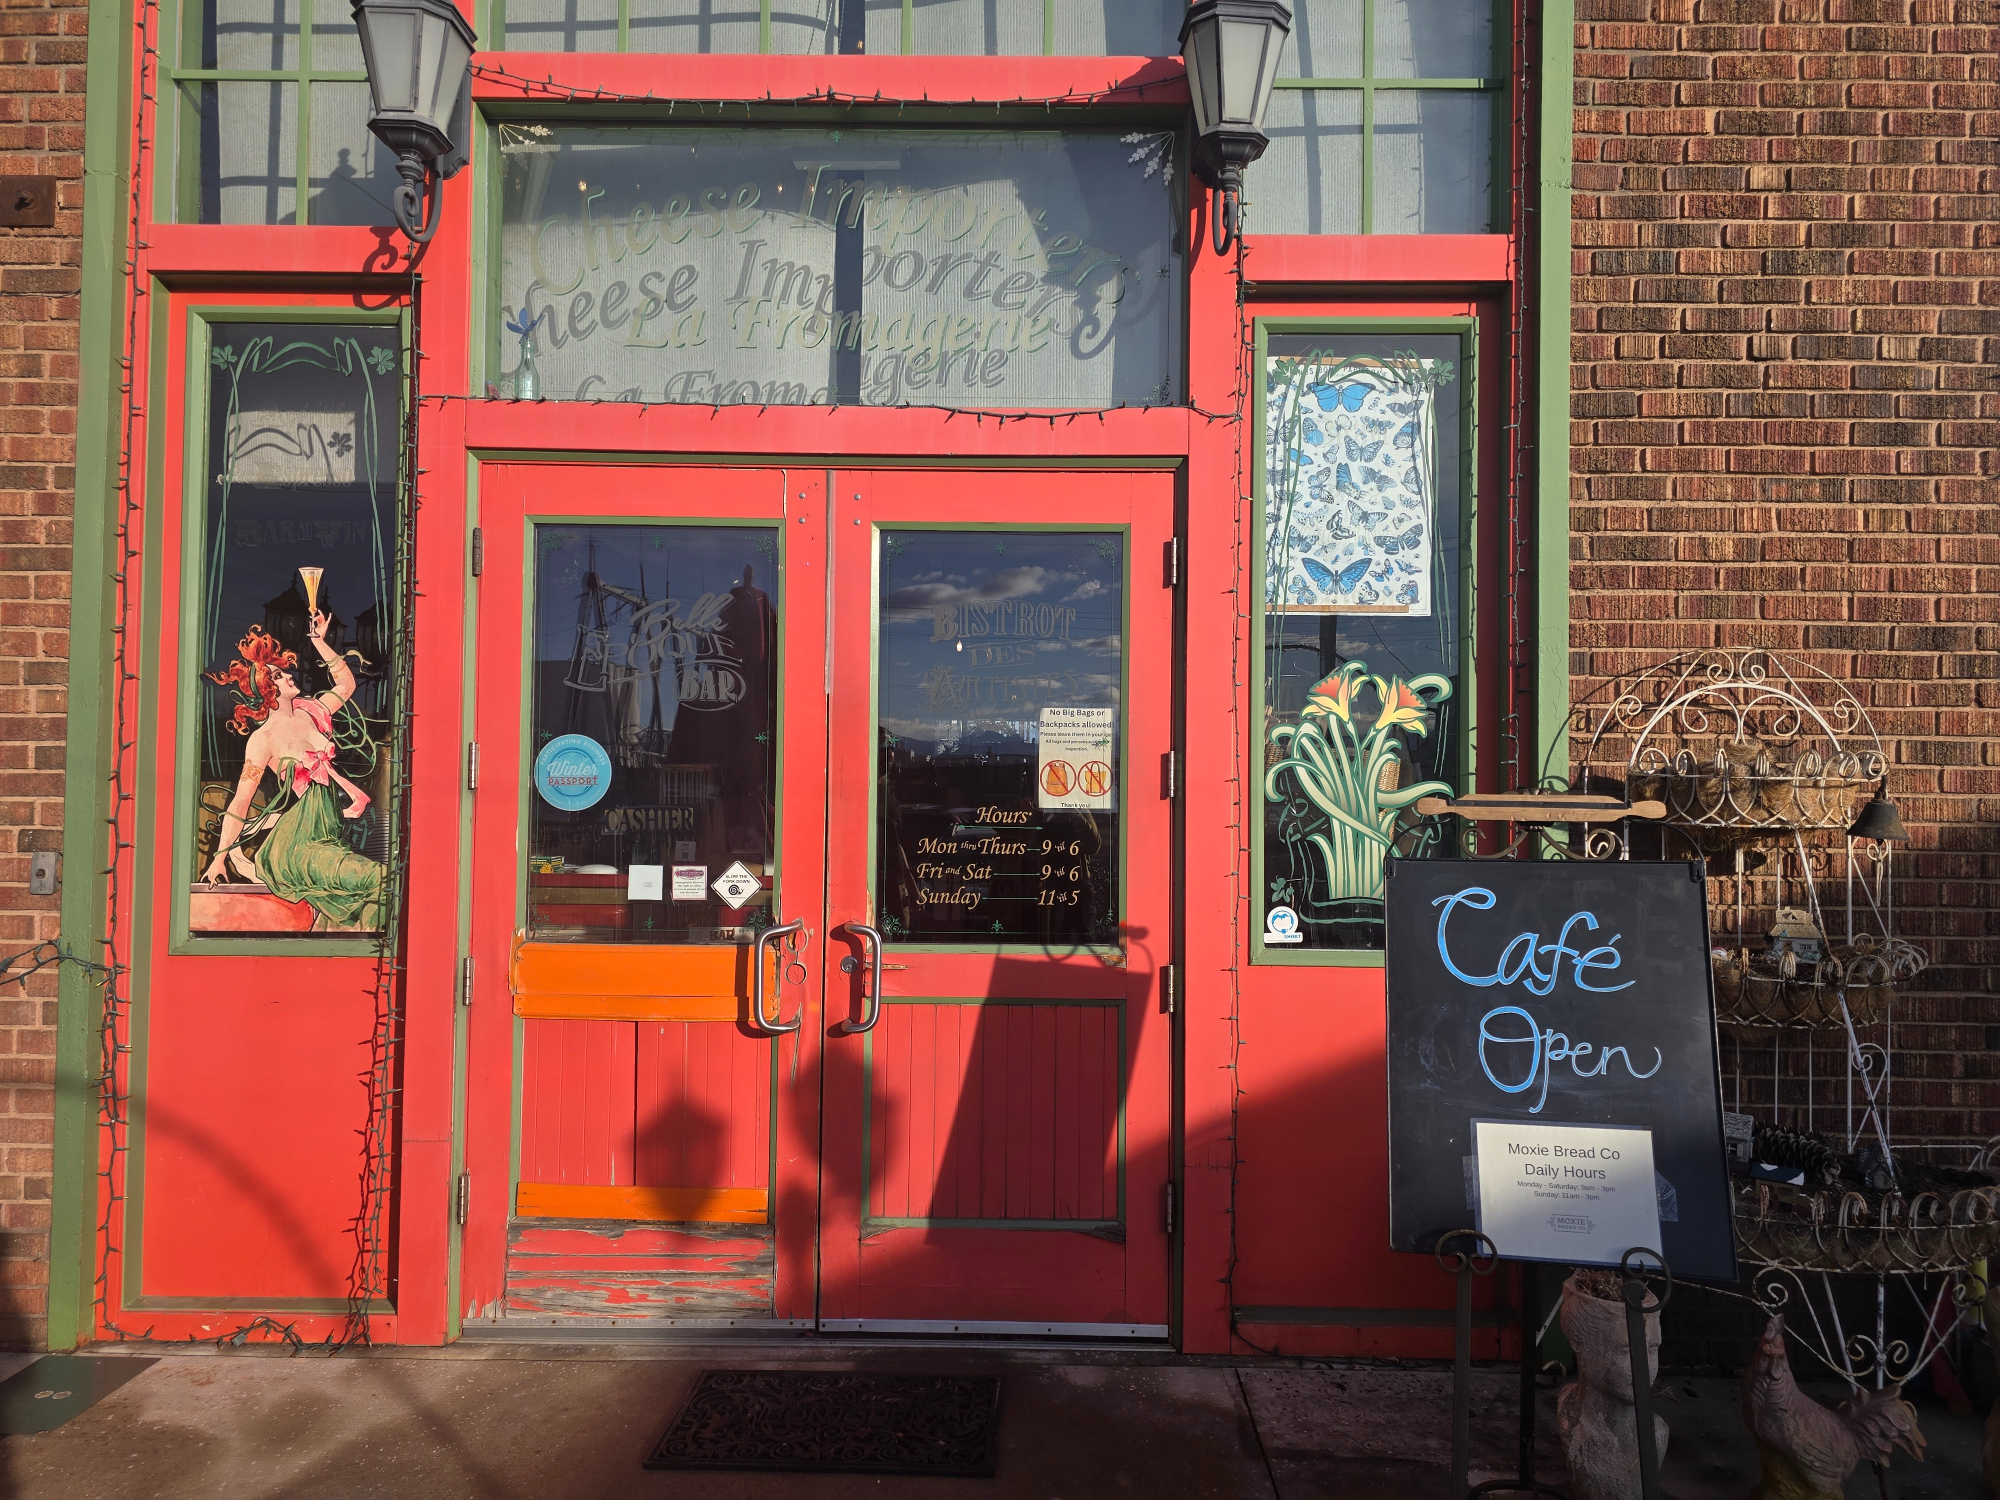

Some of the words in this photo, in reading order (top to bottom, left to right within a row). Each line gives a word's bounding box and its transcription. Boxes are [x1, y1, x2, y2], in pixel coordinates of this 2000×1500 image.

[529, 181, 761, 296] Cheese
[790, 163, 1142, 304] Importers
[622, 296, 707, 349] La
[732, 294, 1053, 374] Fromagerie
[629, 592, 734, 647] Belle
[929, 600, 1077, 643] BISTROT
[968, 643, 1037, 668] DES
[680, 668, 739, 703] BAR
[918, 660, 1079, 713] ARTISTES
[1049, 708, 1061, 716] No
[1062, 708, 1075, 718] Big
[1076, 709, 1095, 718] Bags
[1040, 720, 1081, 731] Backpacks
[1081, 721, 1112, 729] allowed
[540, 738, 582, 766] PARTICIPATING
[582, 740, 607, 766] BUSINESS
[546, 760, 600, 777] Winter
[548, 777, 598, 785] PASSPORT
[604, 807, 694, 833] CASHIER
[916, 837, 958, 855] Mon
[960, 840, 977, 851] thru
[977, 836, 1027, 856] Thurs
[1040, 839, 1052, 856] 9
[1069, 839, 1081, 856] 6
[916, 862, 945, 880] Fri
[944, 865, 963, 875] and
[962, 862, 993, 881] Sat
[1040, 864, 1052, 881] 9
[1068, 865, 1081, 882] 6
[916, 885, 981, 910] Sunday
[1037, 889, 1056, 906] 11
[1068, 889, 1081, 906] 5
[1431, 886, 1637, 996] Café
[1478, 1006, 1663, 1114] Open
[1508, 1142, 1549, 1157] Moxie
[1553, 1145, 1596, 1159] Bread
[1600, 1147, 1621, 1160] Co
[1524, 1163, 1560, 1180] Daily
[1563, 1165, 1606, 1180] Hours
[1517, 1180, 1543, 1190] Monday
[1548, 1183, 1580, 1191] Saturday:
[1581, 1184, 1596, 1192] 9am
[1533, 1190, 1561, 1199] Sunday:
[1561, 1192, 1580, 1200] 11am
[1585, 1194, 1600, 1202] 3pm
[1556, 1217, 1586, 1226] MOXIE
[764, 1405, 910, 1426] BONJOUR
